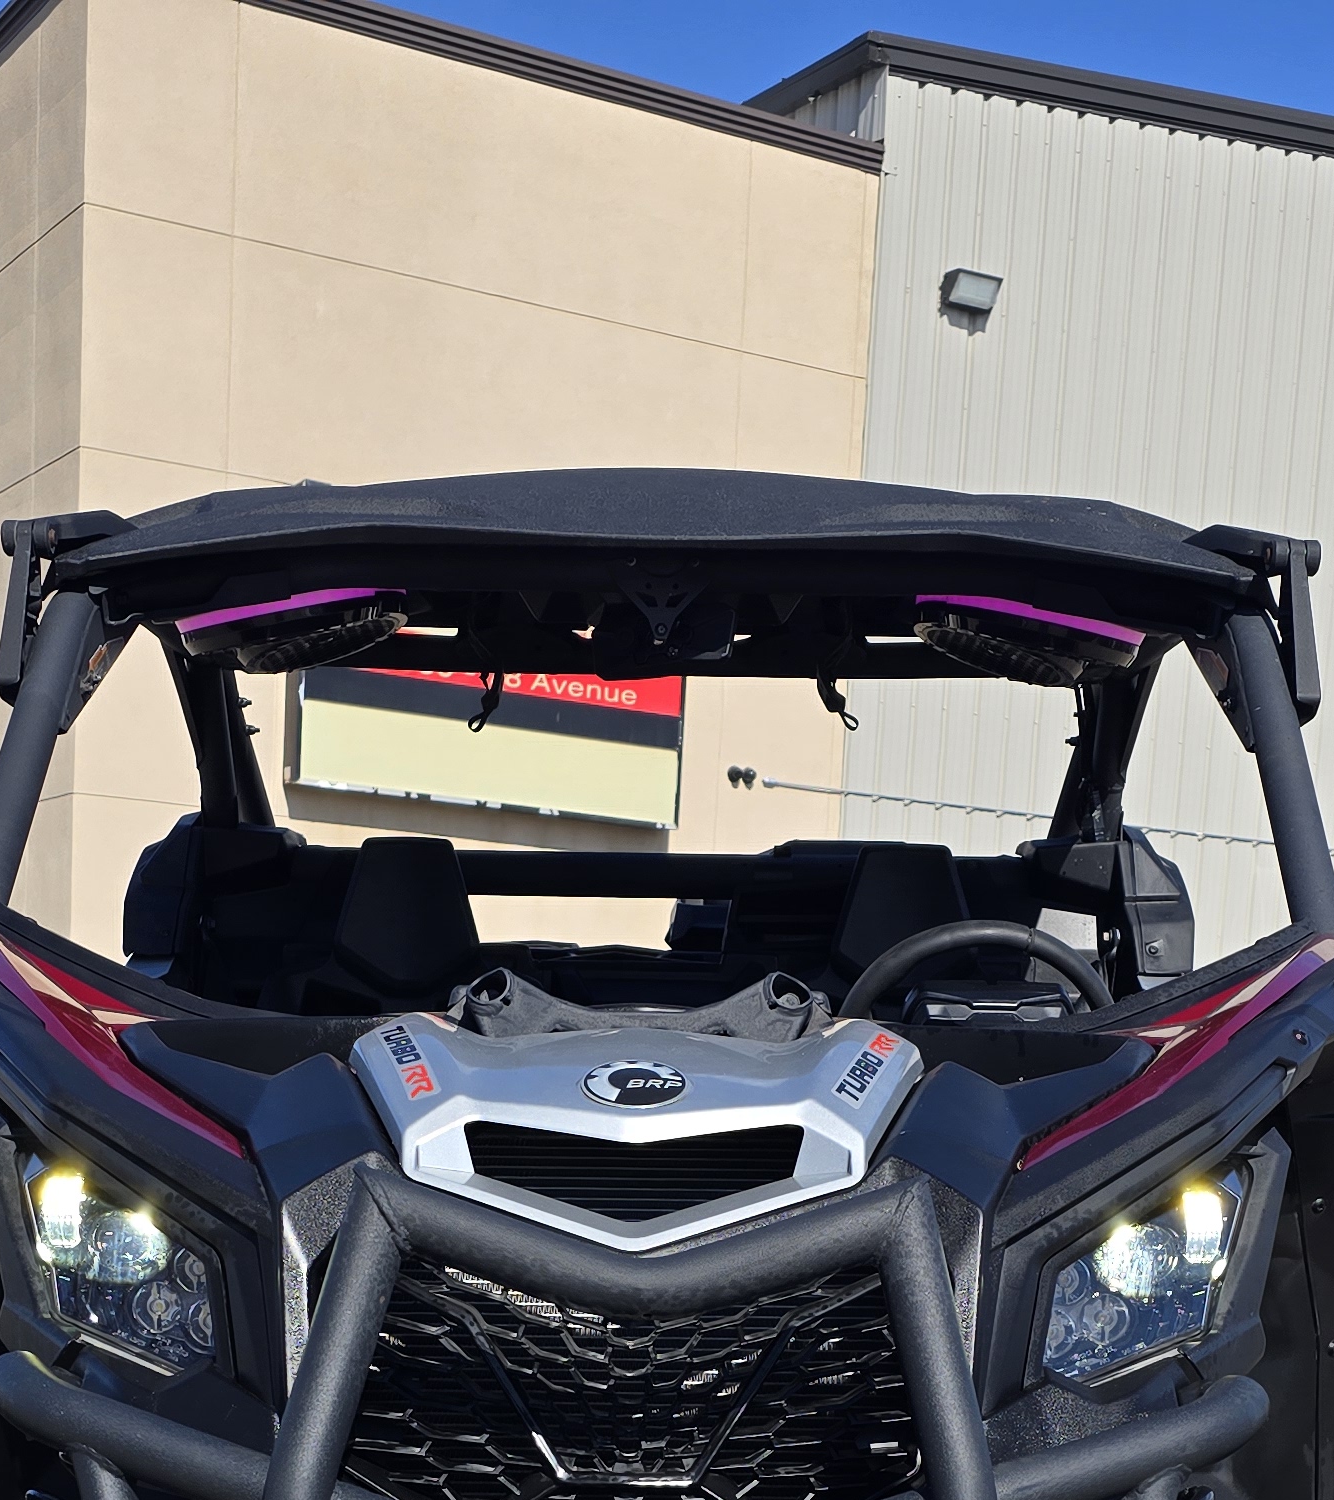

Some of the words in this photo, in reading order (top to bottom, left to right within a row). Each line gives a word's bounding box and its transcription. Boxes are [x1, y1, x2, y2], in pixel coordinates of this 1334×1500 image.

[531, 674, 637, 705] Avenue
[380, 1025, 422, 1065] TURBO
[401, 1063, 434, 1099] RR
[626, 1078, 683, 1089] BRP
[835, 1050, 884, 1101] TURBO
[869, 1033, 900, 1058] RR
